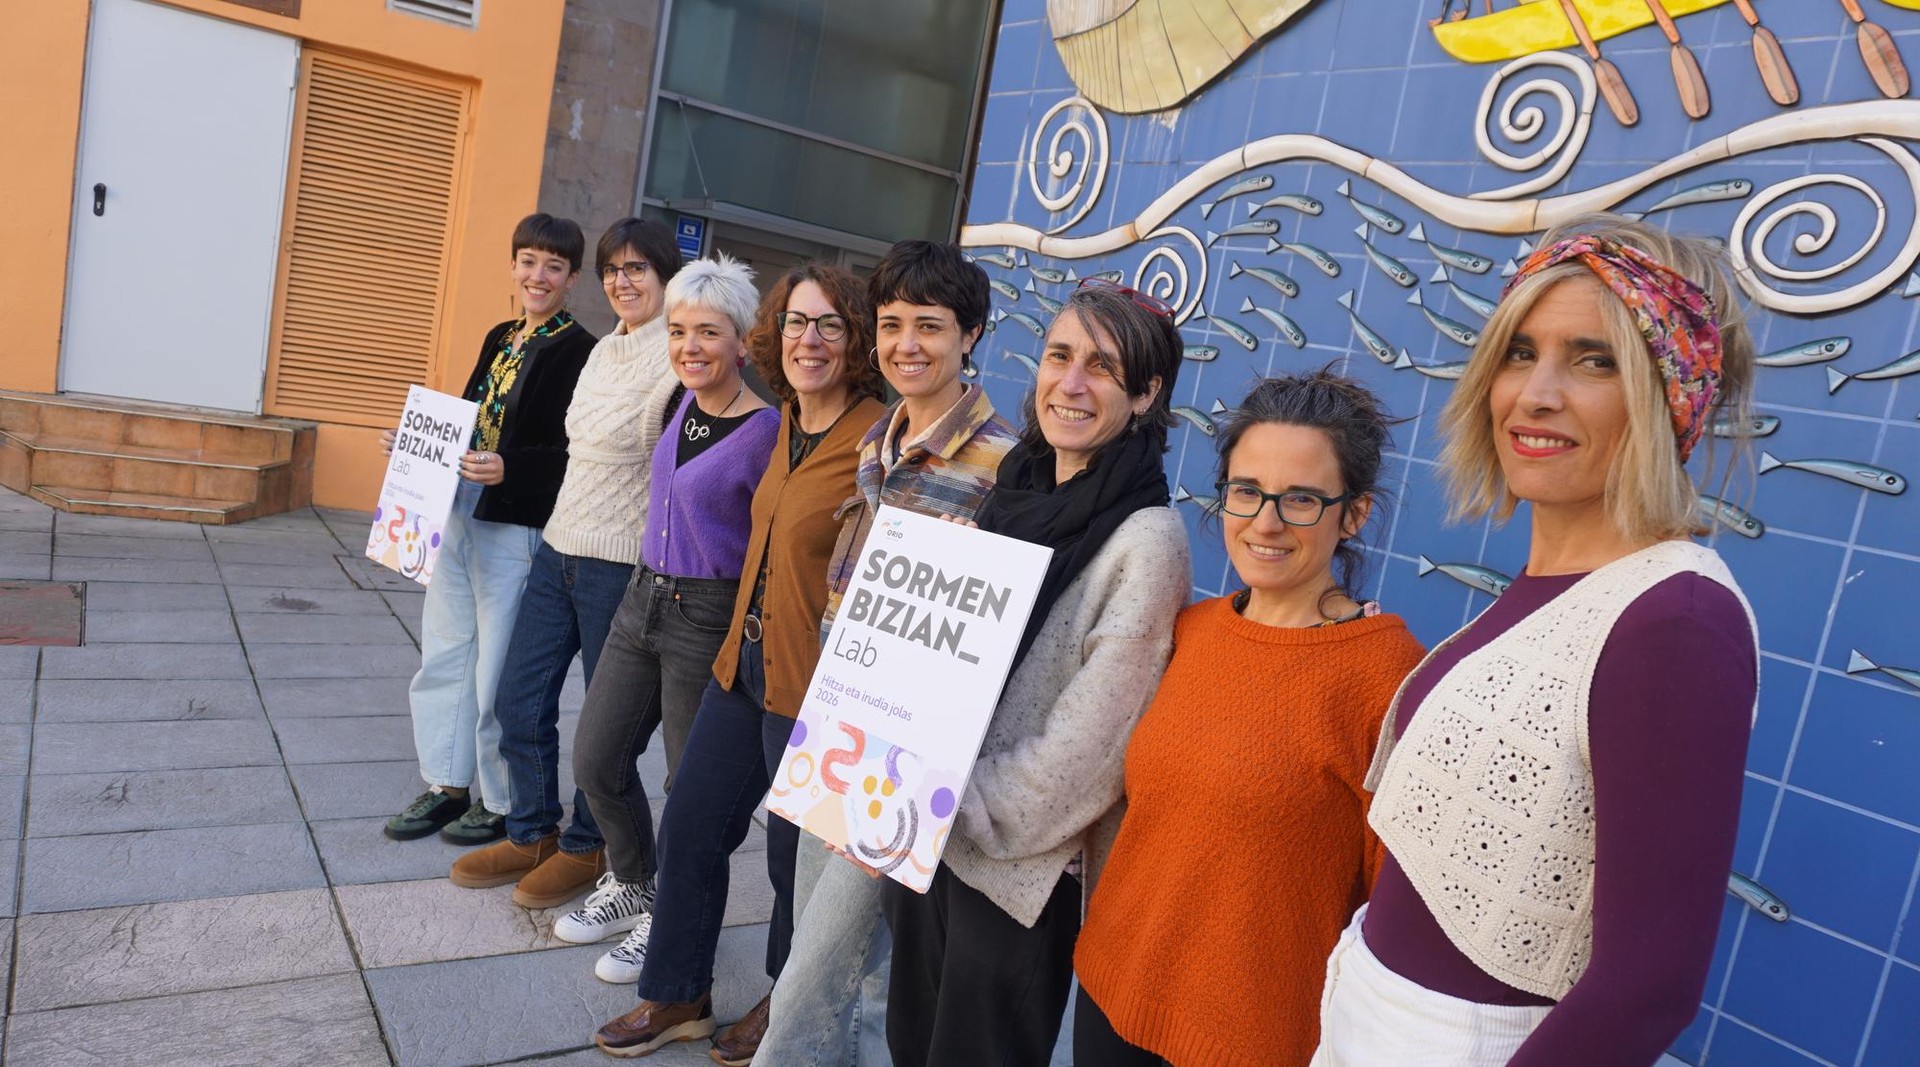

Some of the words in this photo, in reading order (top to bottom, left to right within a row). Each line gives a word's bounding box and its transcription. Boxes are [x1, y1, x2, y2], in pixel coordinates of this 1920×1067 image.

[404, 410, 462, 445] SORMEN
[392, 455, 411, 476] Lab
[398, 432, 450, 468] BIZIAN_
[887, 529, 903, 538] ORIO
[862, 549, 1012, 623] SORMEN
[846, 588, 980, 666] BIZIAN_
[833, 627, 877, 668] Lab
[815, 687, 839, 707] 2026
[821, 674, 845, 693] Hitza
[845, 686, 861, 700] eta
[861, 691, 889, 712] irudia
[887, 702, 913, 722] jolas
